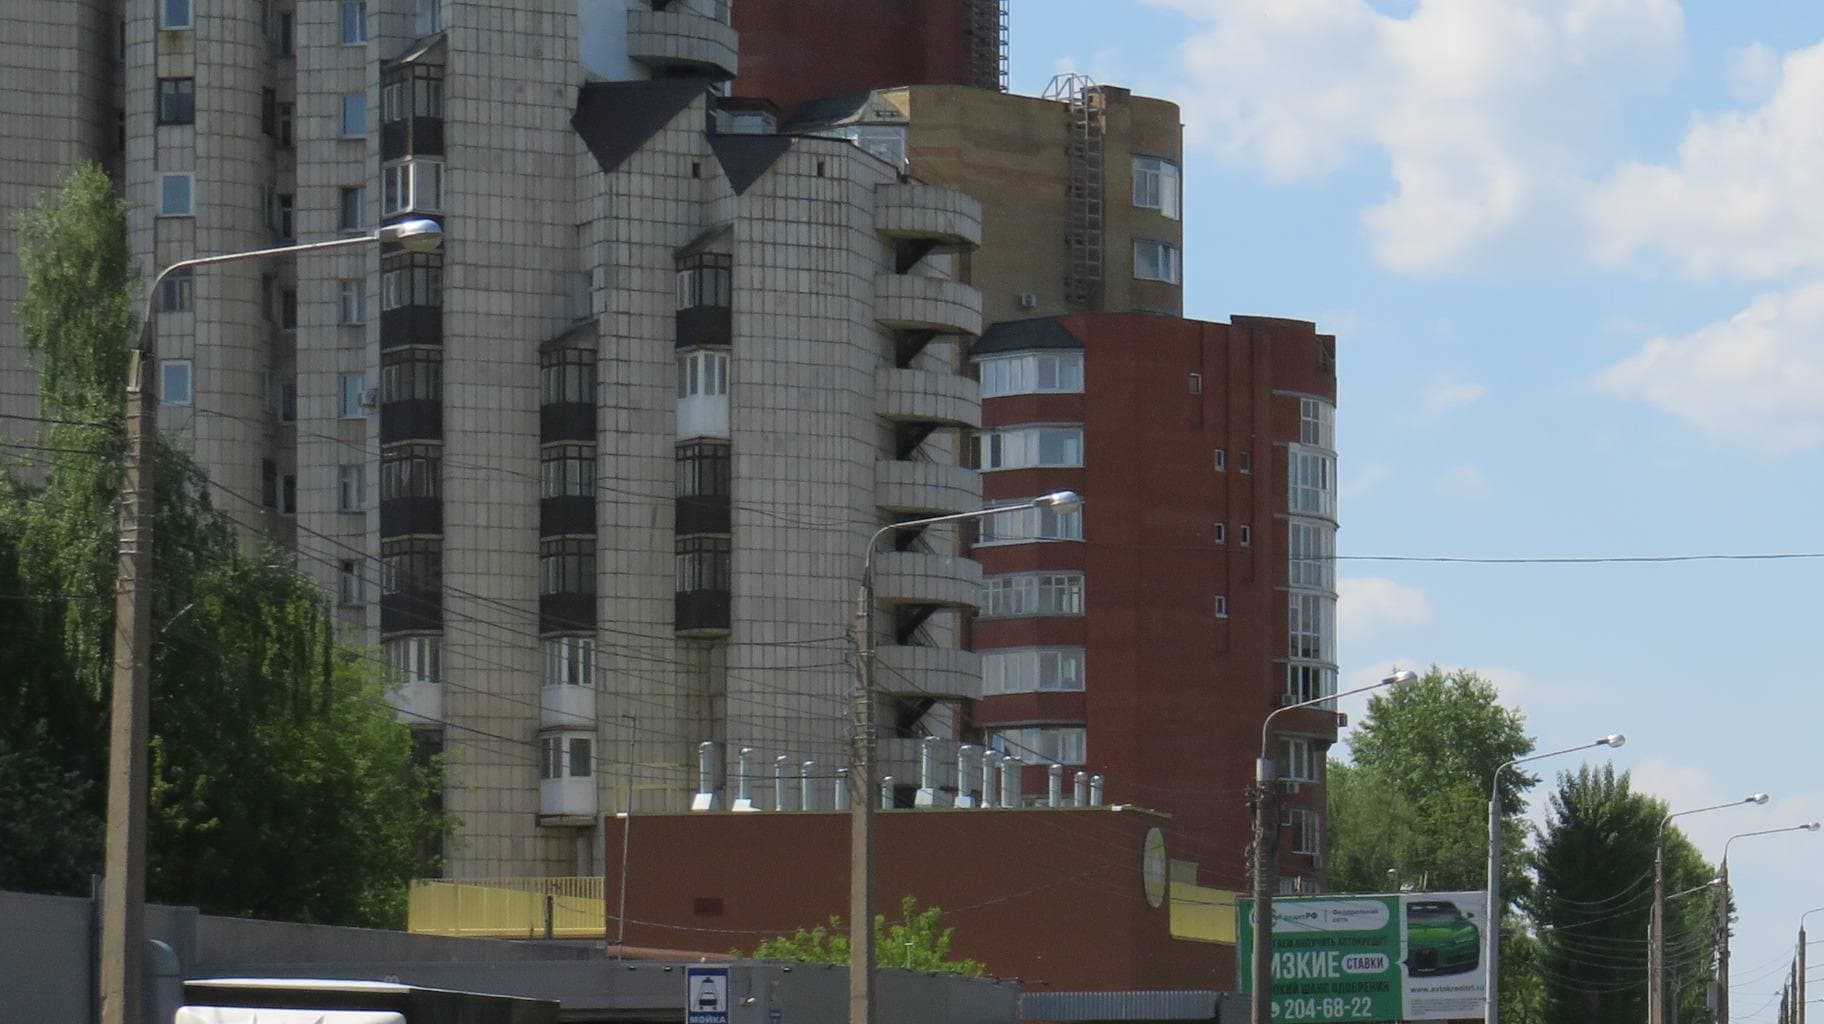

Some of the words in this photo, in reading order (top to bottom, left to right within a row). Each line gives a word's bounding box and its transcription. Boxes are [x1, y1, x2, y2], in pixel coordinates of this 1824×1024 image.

[1346, 957, 1384, 970] СТАВКИ
[1284, 997, 1372, 1019] 204-68-22
[690, 1015, 726, 1023] МОЙКА
